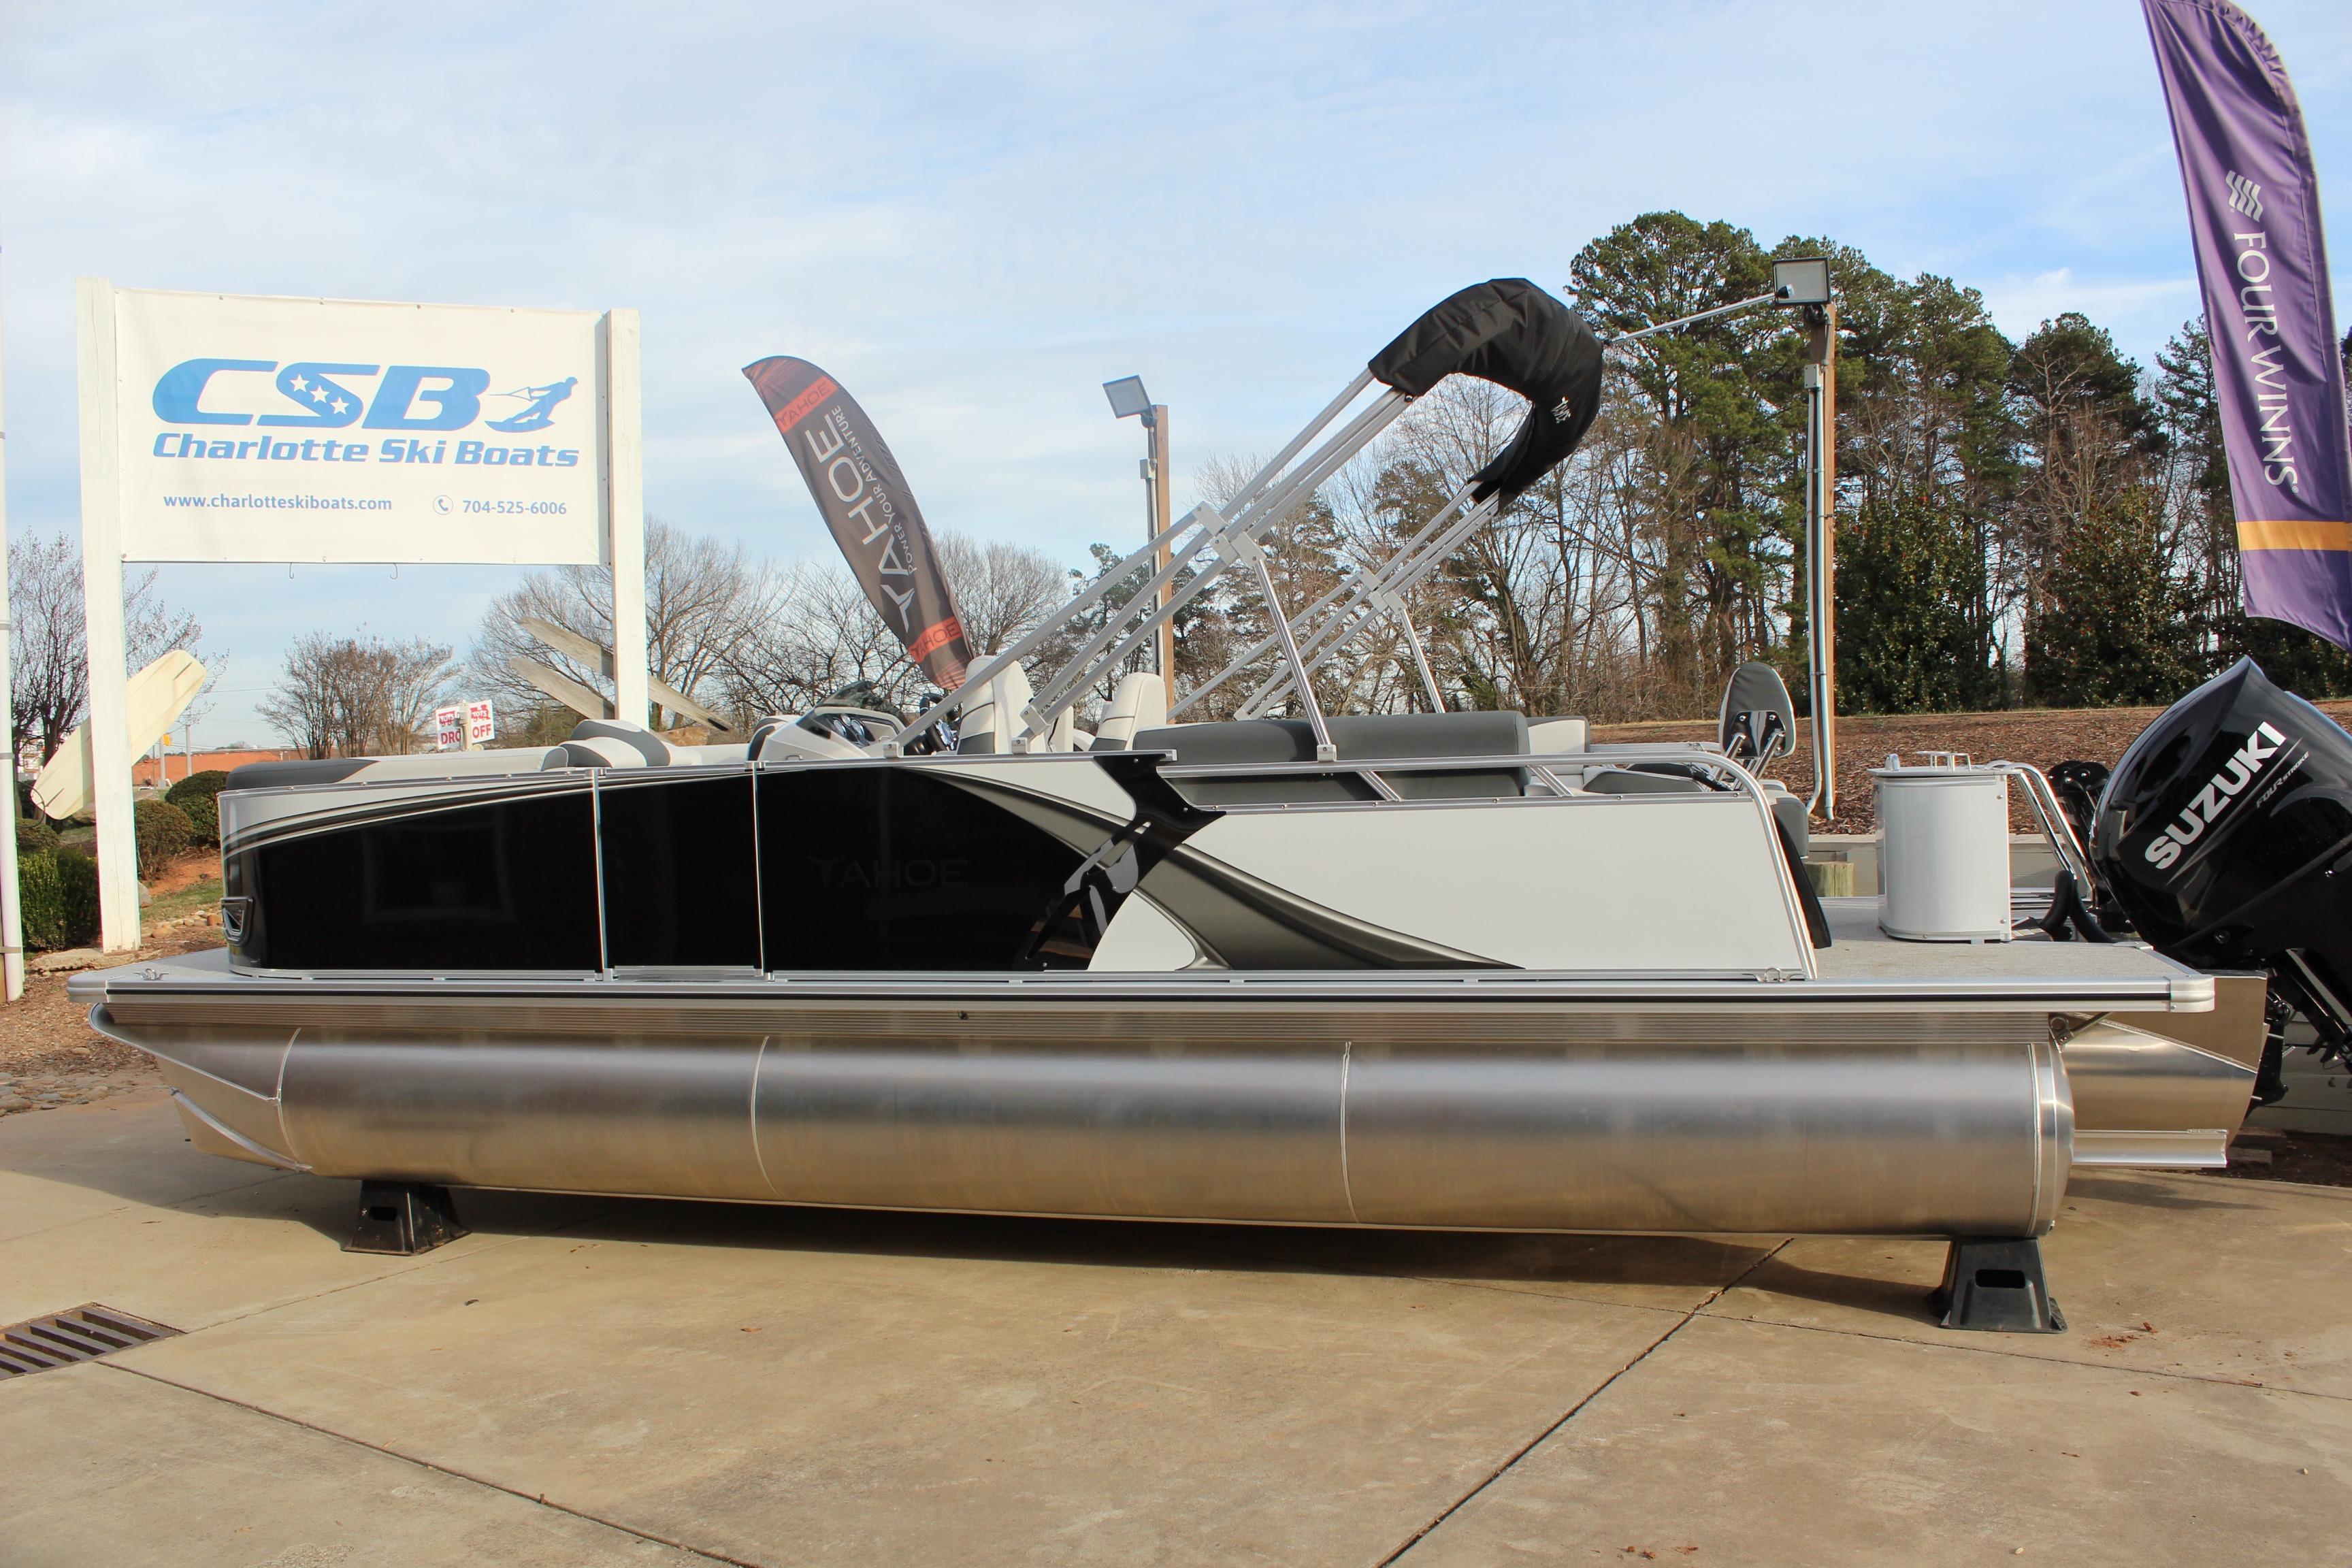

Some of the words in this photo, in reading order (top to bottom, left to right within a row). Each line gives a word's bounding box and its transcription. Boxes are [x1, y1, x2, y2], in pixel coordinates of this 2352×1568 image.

[2234, 231, 2278, 342] FOUR
[152, 358, 491, 431] CSB
[774, 380, 830, 428] TAHOE
[152, 431, 368, 463] Charlotte
[378, 438, 446, 465] Ski
[455, 440, 579, 468] Boats
[831, 405, 877, 483] ADVENTURE
[163, 493, 393, 512] www.charlotteskiboats.com
[462, 500, 568, 515] 704-525-6006
[805, 413, 915, 634] TAHOE
[873, 485, 896, 523] YOUR
[894, 522, 917, 574] POWER
[441, 730, 461, 745] DRO
[473, 724, 491, 738] OFF
[2144, 721, 2287, 870] SUZUKI
[806, 855, 968, 891] TAHOE
